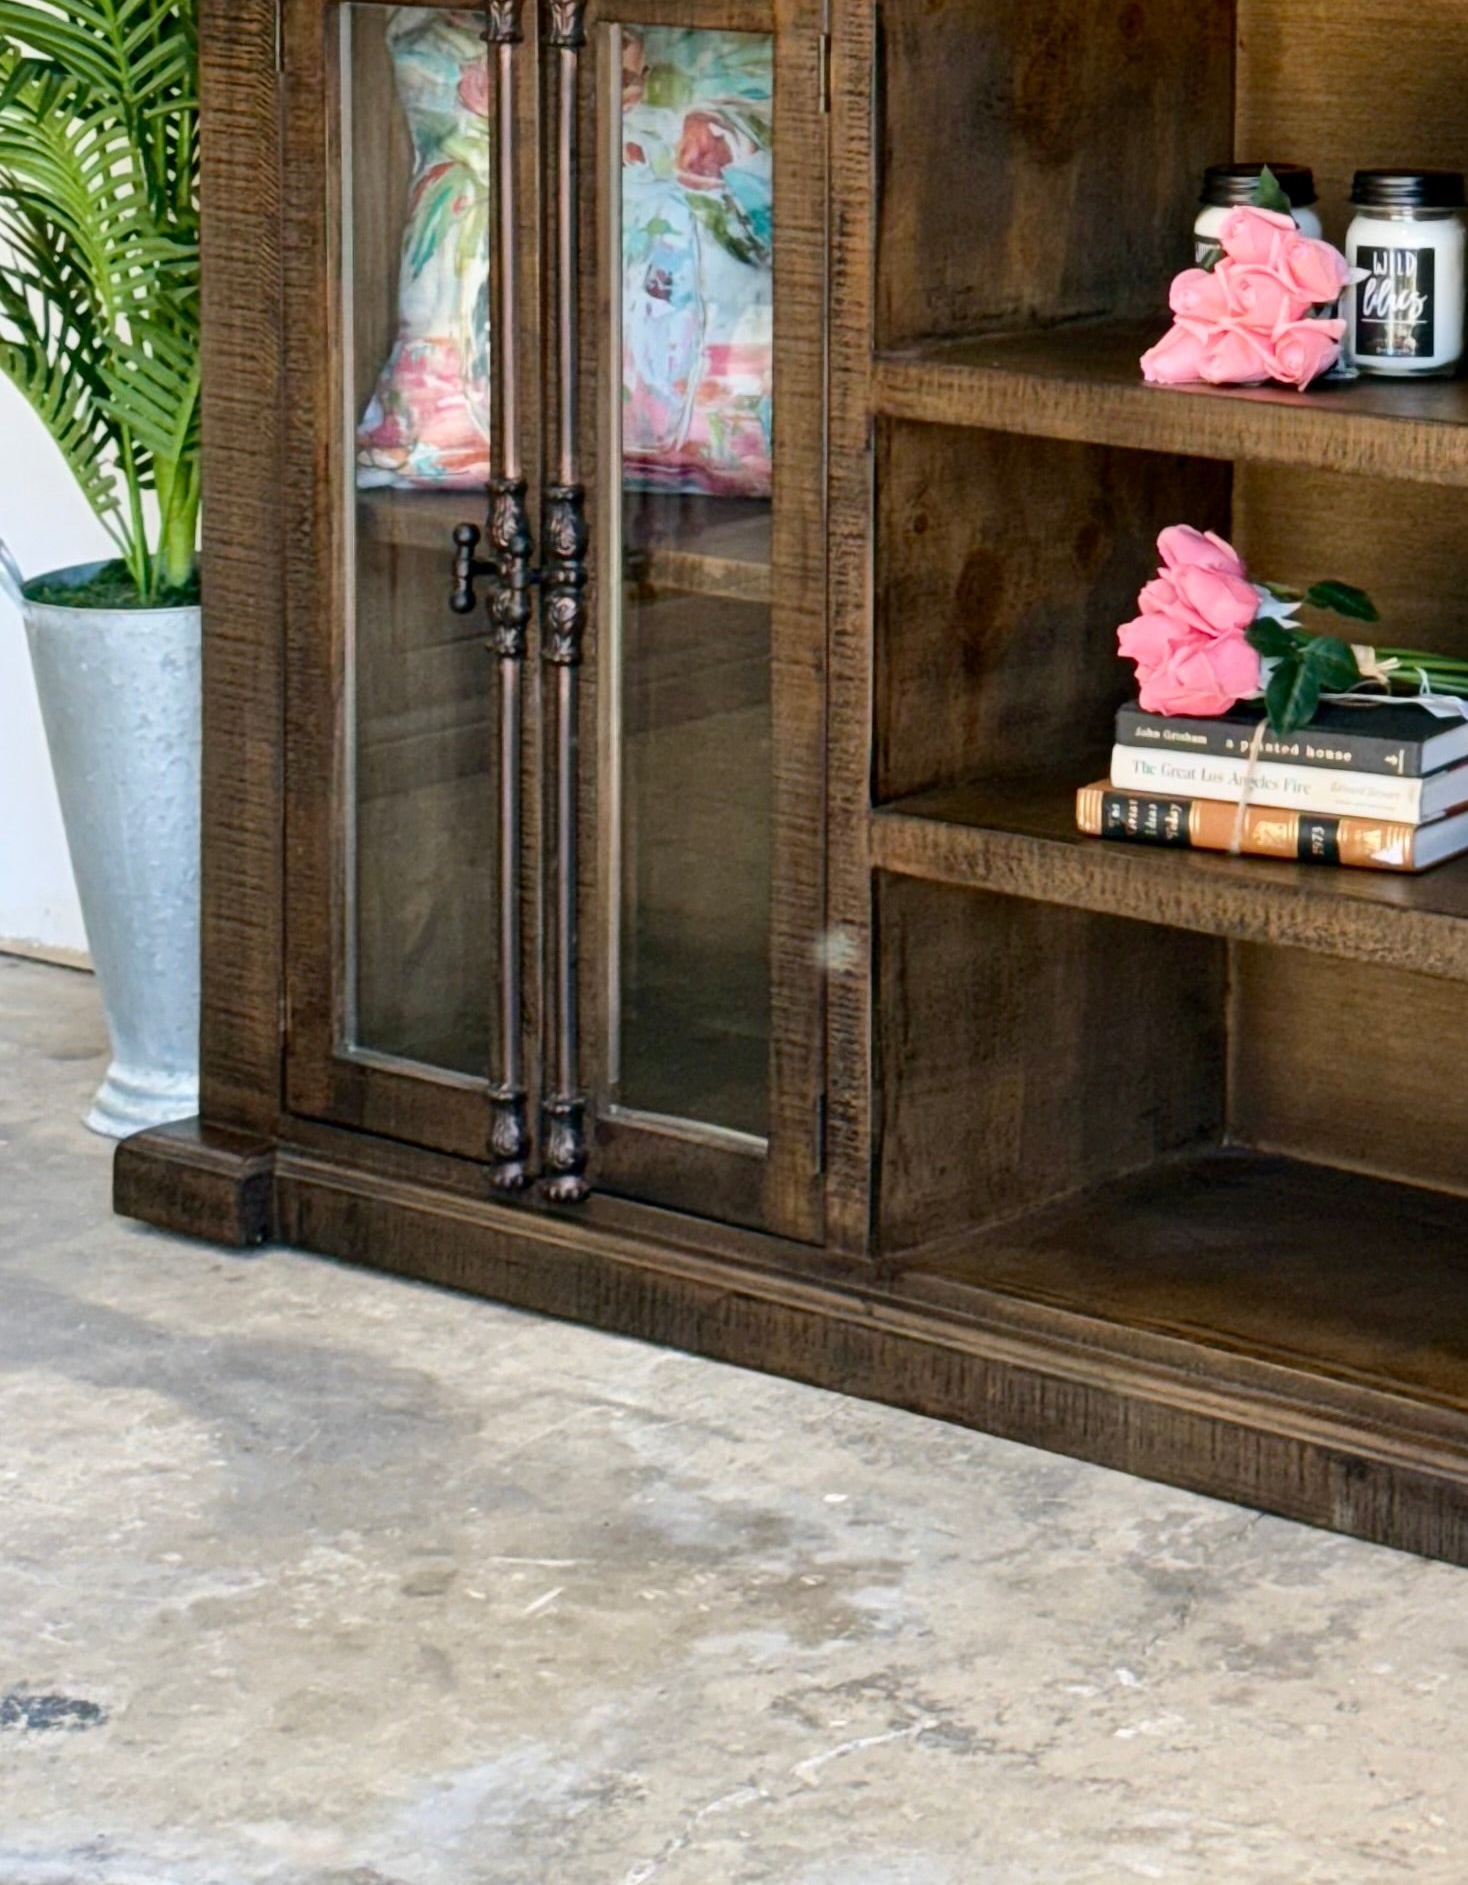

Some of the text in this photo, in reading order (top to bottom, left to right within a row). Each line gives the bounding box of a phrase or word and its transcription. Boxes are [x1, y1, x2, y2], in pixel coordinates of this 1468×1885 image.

[1373, 250, 1418, 277] WILD
[1135, 726, 1208, 745] John Grisham
[1306, 744, 1352, 763] house
[1133, 759, 1155, 775] The
[1161, 762, 1196, 781] Great
[1201, 767, 1223, 784] Los
[1283, 777, 1312, 796] Fire
